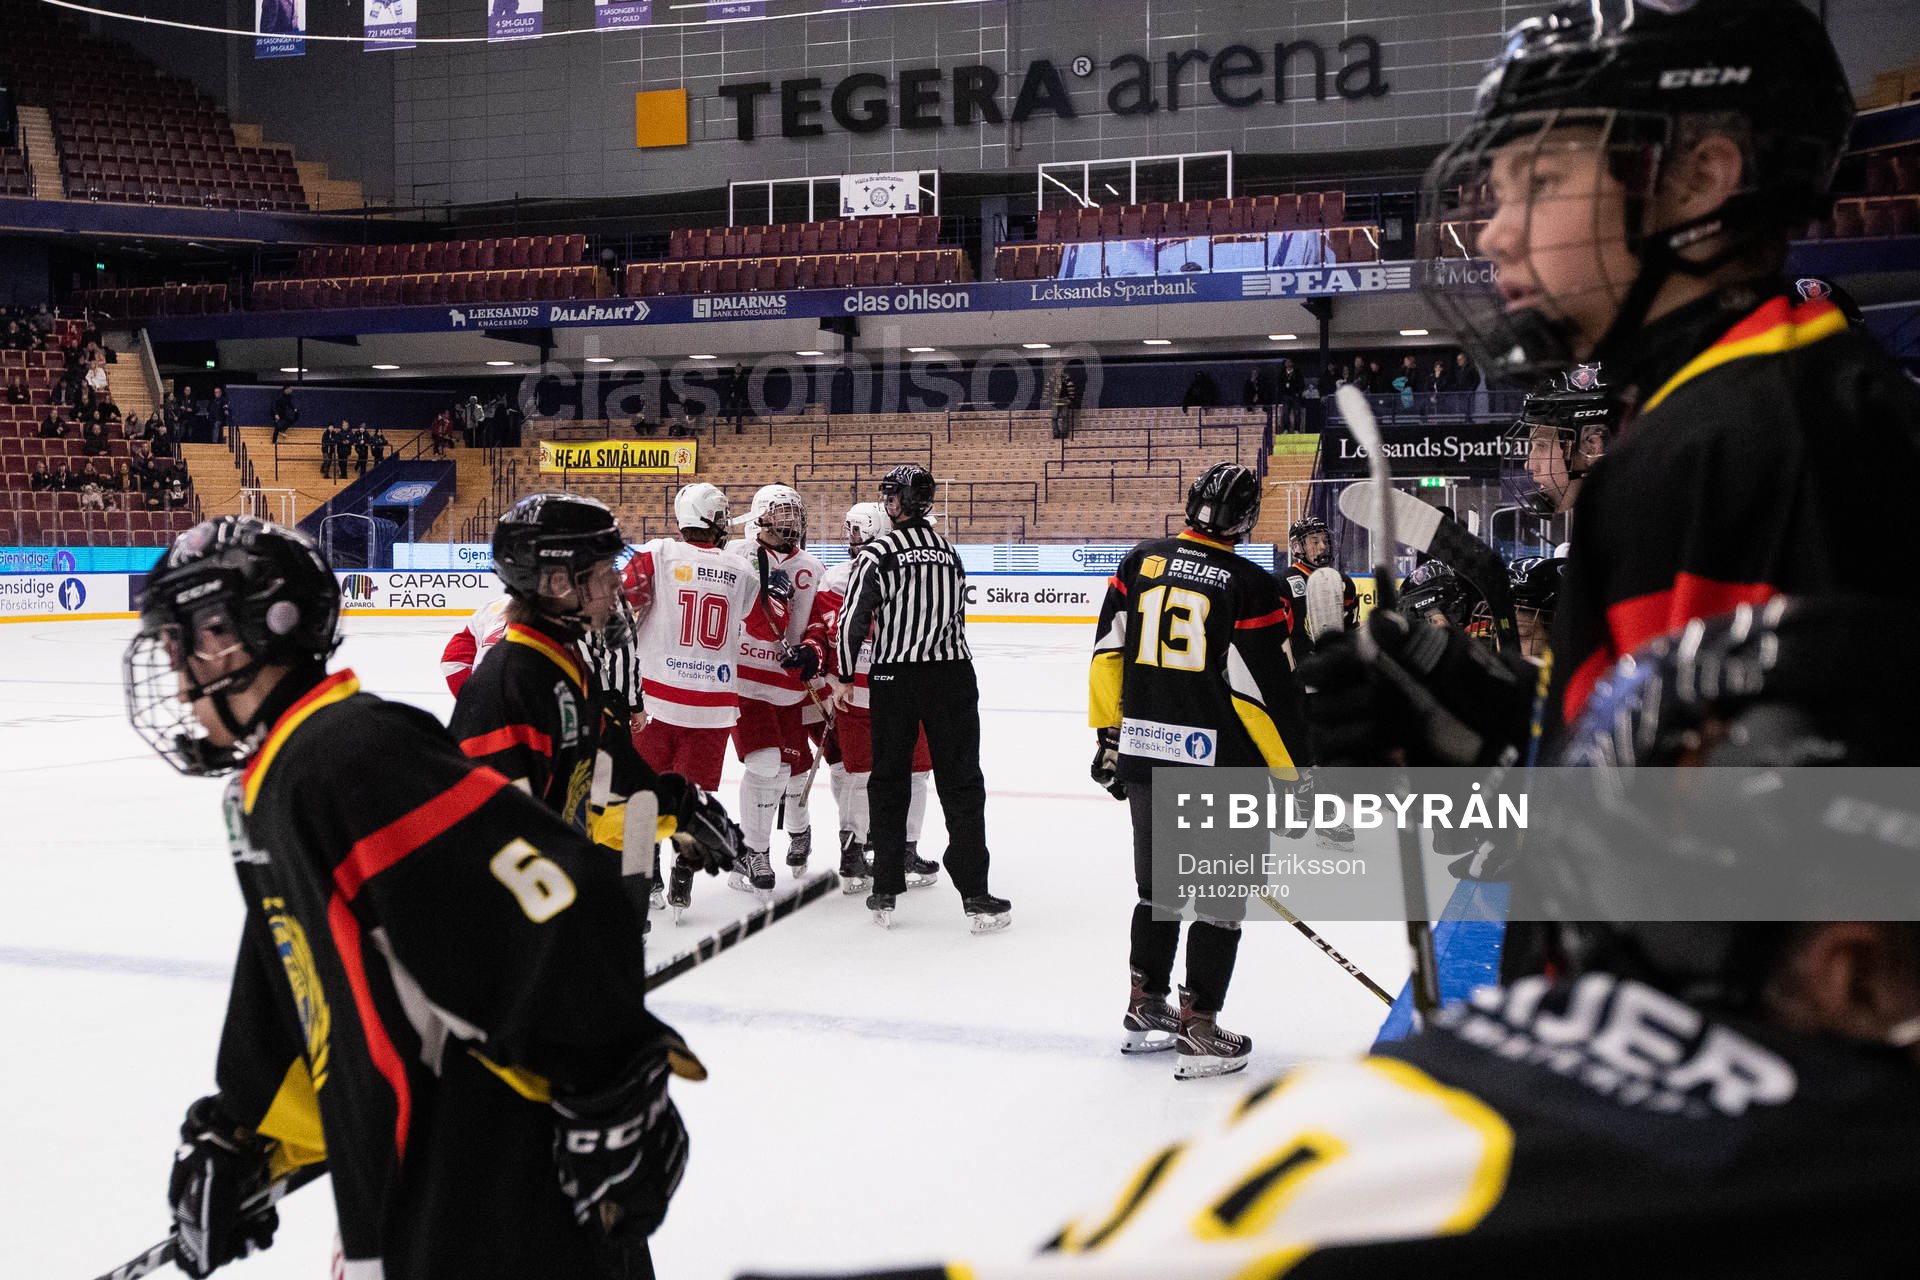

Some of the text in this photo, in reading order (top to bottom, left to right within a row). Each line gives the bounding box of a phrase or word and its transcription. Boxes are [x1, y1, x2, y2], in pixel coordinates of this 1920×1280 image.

[380, 27, 413, 38] MATCHER
[718, 33, 1390, 141] TEGERA arena
[1658, 66, 1752, 90] CCM
[1031, 277, 1198, 302] Leksands Sparbank
[1268, 267, 1389, 296] PEAB
[713, 294, 787, 310] DALARNAS
[844, 289, 969, 313] clas ohlson
[468, 306, 539, 320] LEKSANDS
[712, 309, 732, 318] BANK
[740, 307, 787, 317] FÖRSÄKRING
[1574, 409, 1609, 418] CCM
[555, 443, 670, 468] HEJA SMÅLAND
[1339, 436, 1441, 459] Lesands
[458, 547, 494, 563] Gjens
[897, 549, 955, 567] PERSSON
[1176, 546, 1208, 559] Reebok
[697, 566, 737, 584] BEIJER
[794, 569, 813, 590] C
[1167, 570, 1227, 591] BYGGMATERIAL
[1169, 558, 1232, 584] BEIJER
[389, 574, 489, 588] CAPAROL
[344, 601, 376, 609] CAPAROL
[389, 590, 446, 608] FÄRG
[986, 588, 1090, 604] Säkra dörrar.
[679, 589, 730, 651] 10
[1134, 585, 1211, 673] 13
[666, 657, 716, 674] Gjensidige
[873, 674, 895, 682] CCM
[1130, 737, 1182, 758] Försäkring
[489, 837, 578, 924] 6
[1310, 933, 1363, 977] CCM
